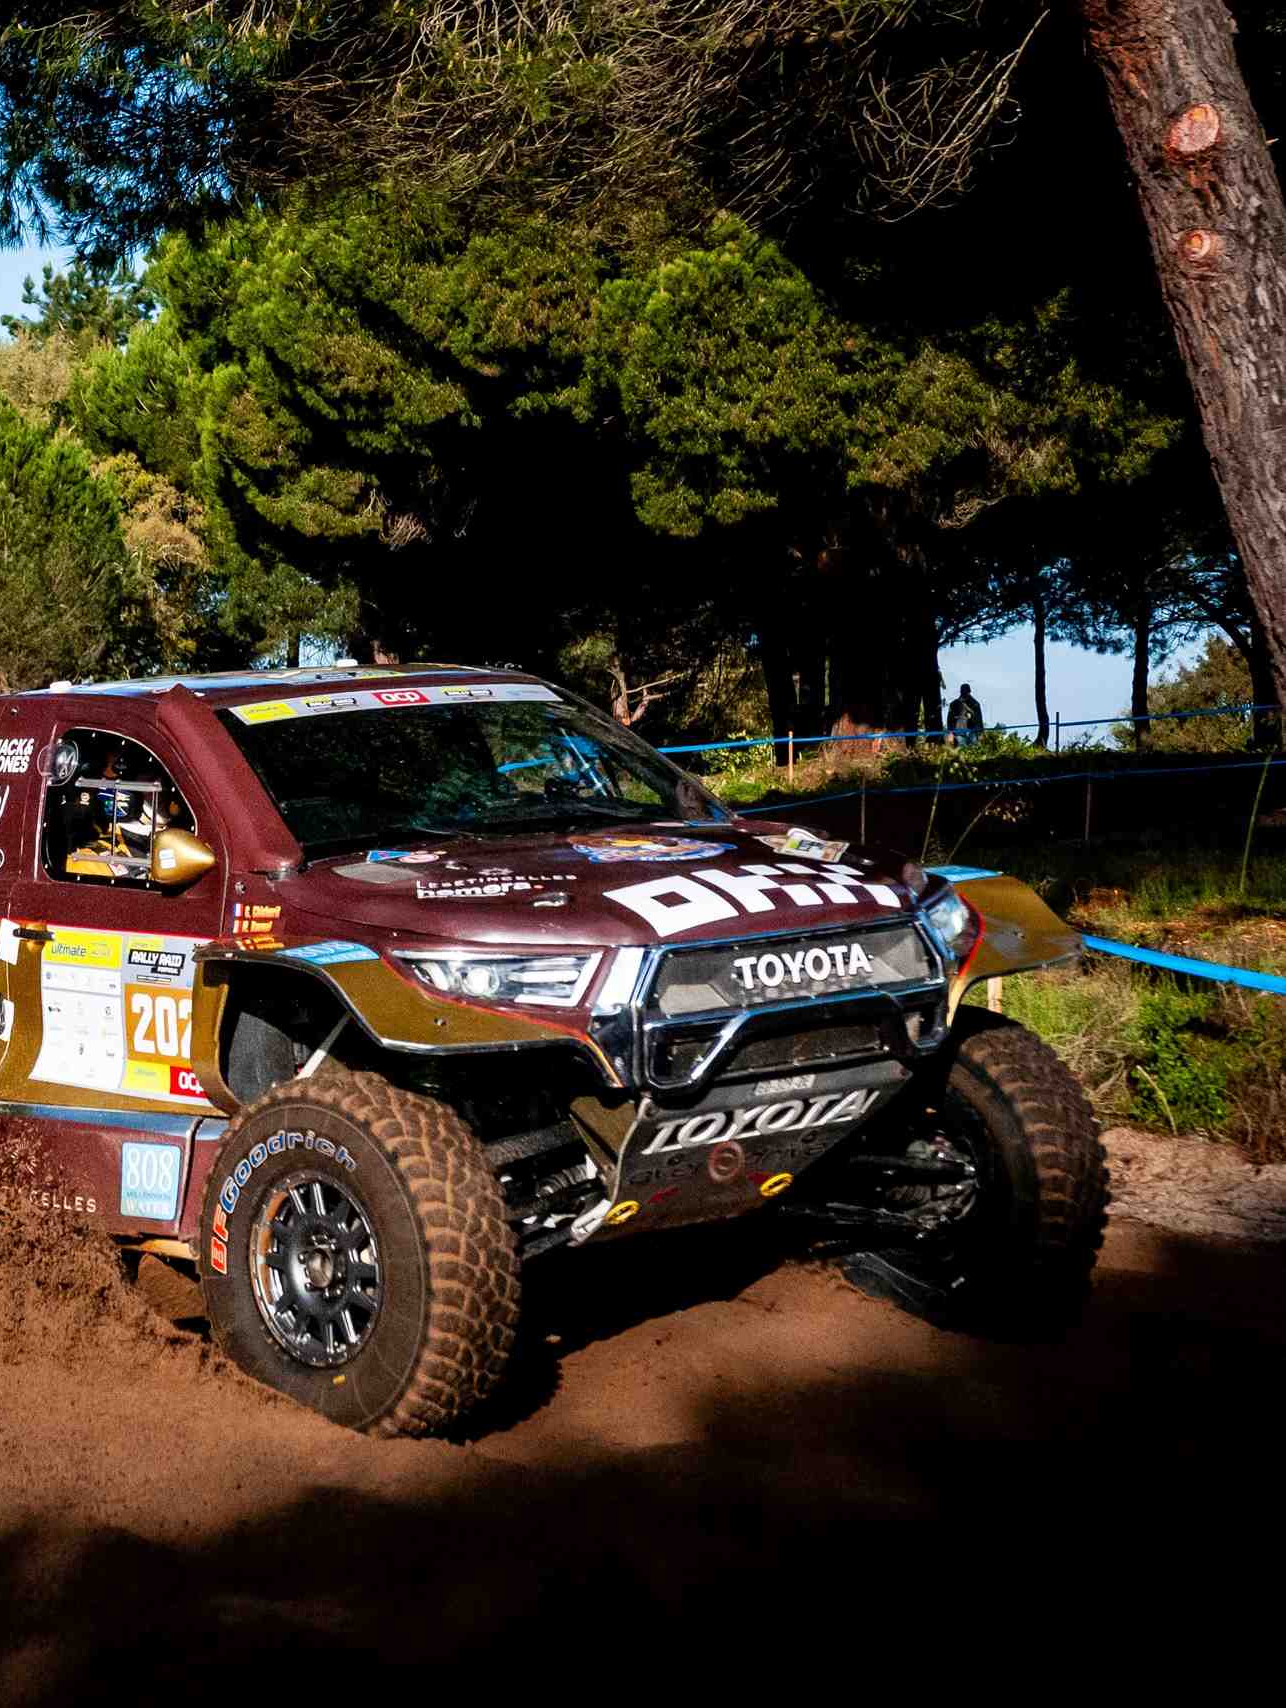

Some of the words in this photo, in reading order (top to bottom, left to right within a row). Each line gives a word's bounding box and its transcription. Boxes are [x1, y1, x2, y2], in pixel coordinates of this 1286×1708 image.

[130, 950, 159, 965] RALLY
[159, 953, 183, 968] RAID
[732, 943, 874, 990] TOYOTA
[642, 1089, 880, 1155] TOYOTA
[126, 1148, 174, 1191] 808
[211, 1130, 358, 1275] BFGoodrich
